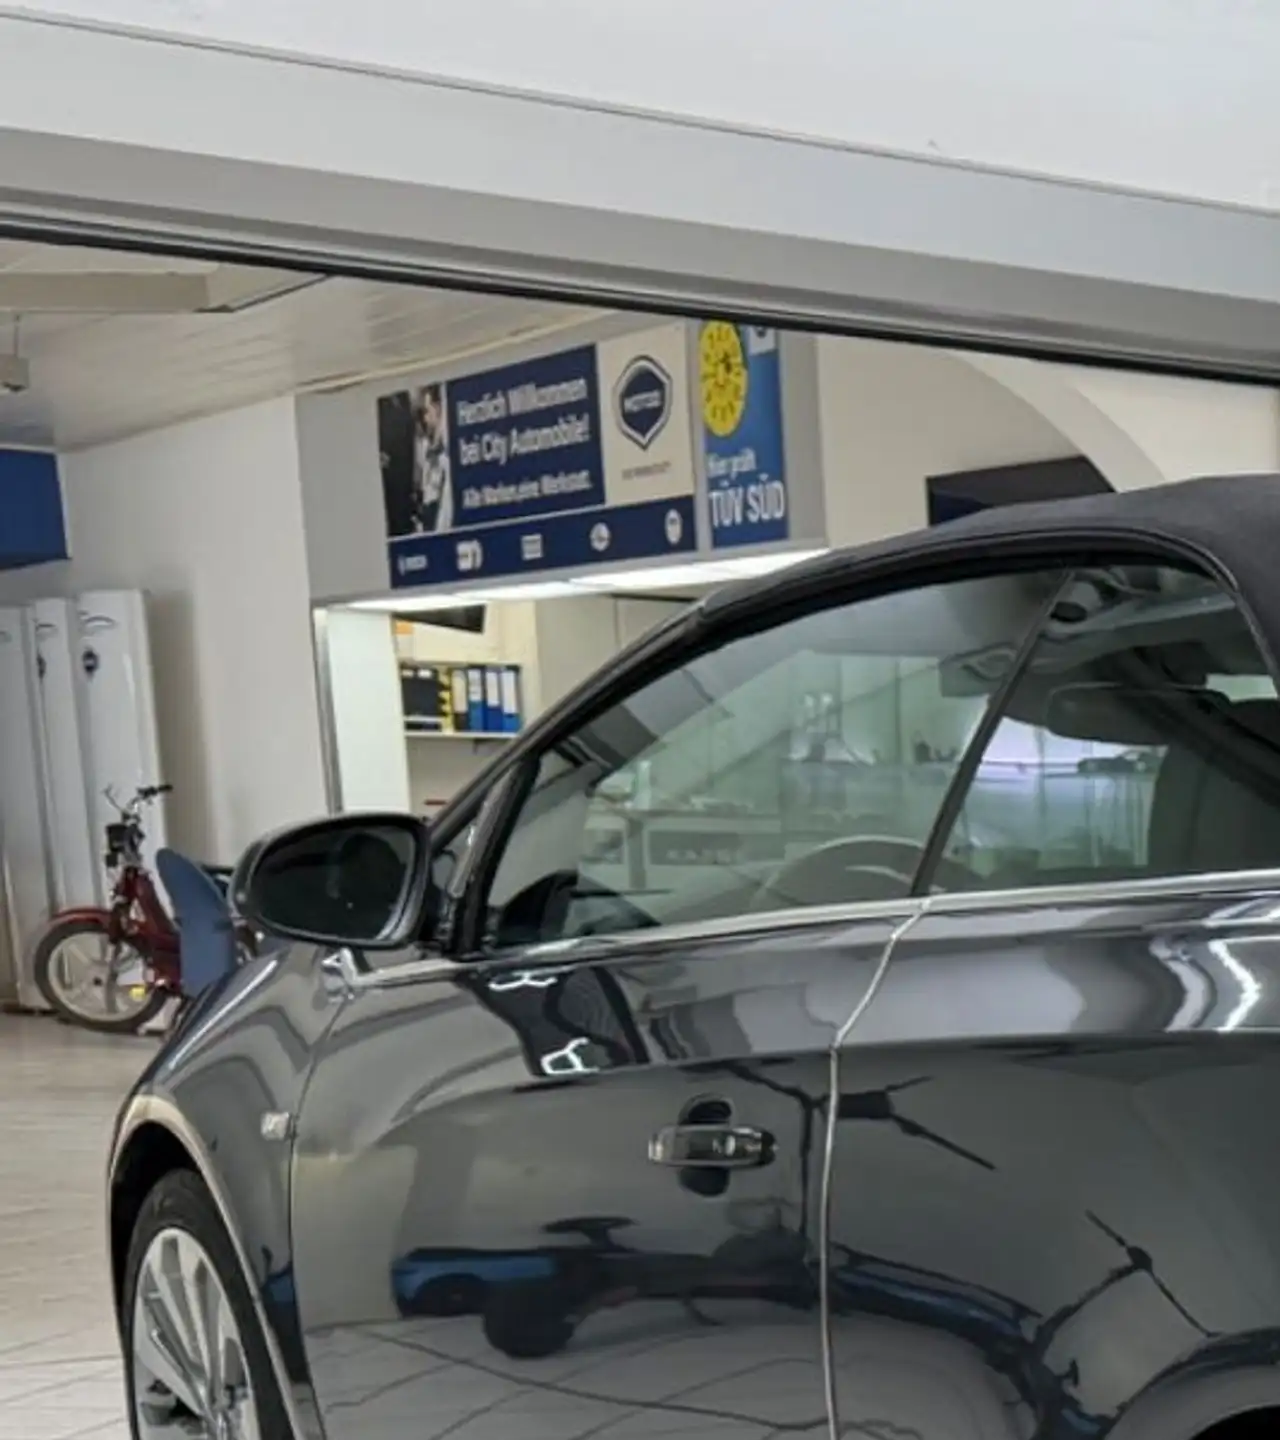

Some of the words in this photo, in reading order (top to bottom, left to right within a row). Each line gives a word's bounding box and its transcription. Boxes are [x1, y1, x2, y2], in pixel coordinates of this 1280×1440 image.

[456, 391, 506, 427] Herzlich
[508, 379, 588, 416] Willkommen
[459, 434, 481, 466] bei
[482, 431, 507, 466] City
[510, 412, 590, 457] Automobile!
[708, 480, 743, 527] TÜV
[746, 472, 784, 523] SÜD
